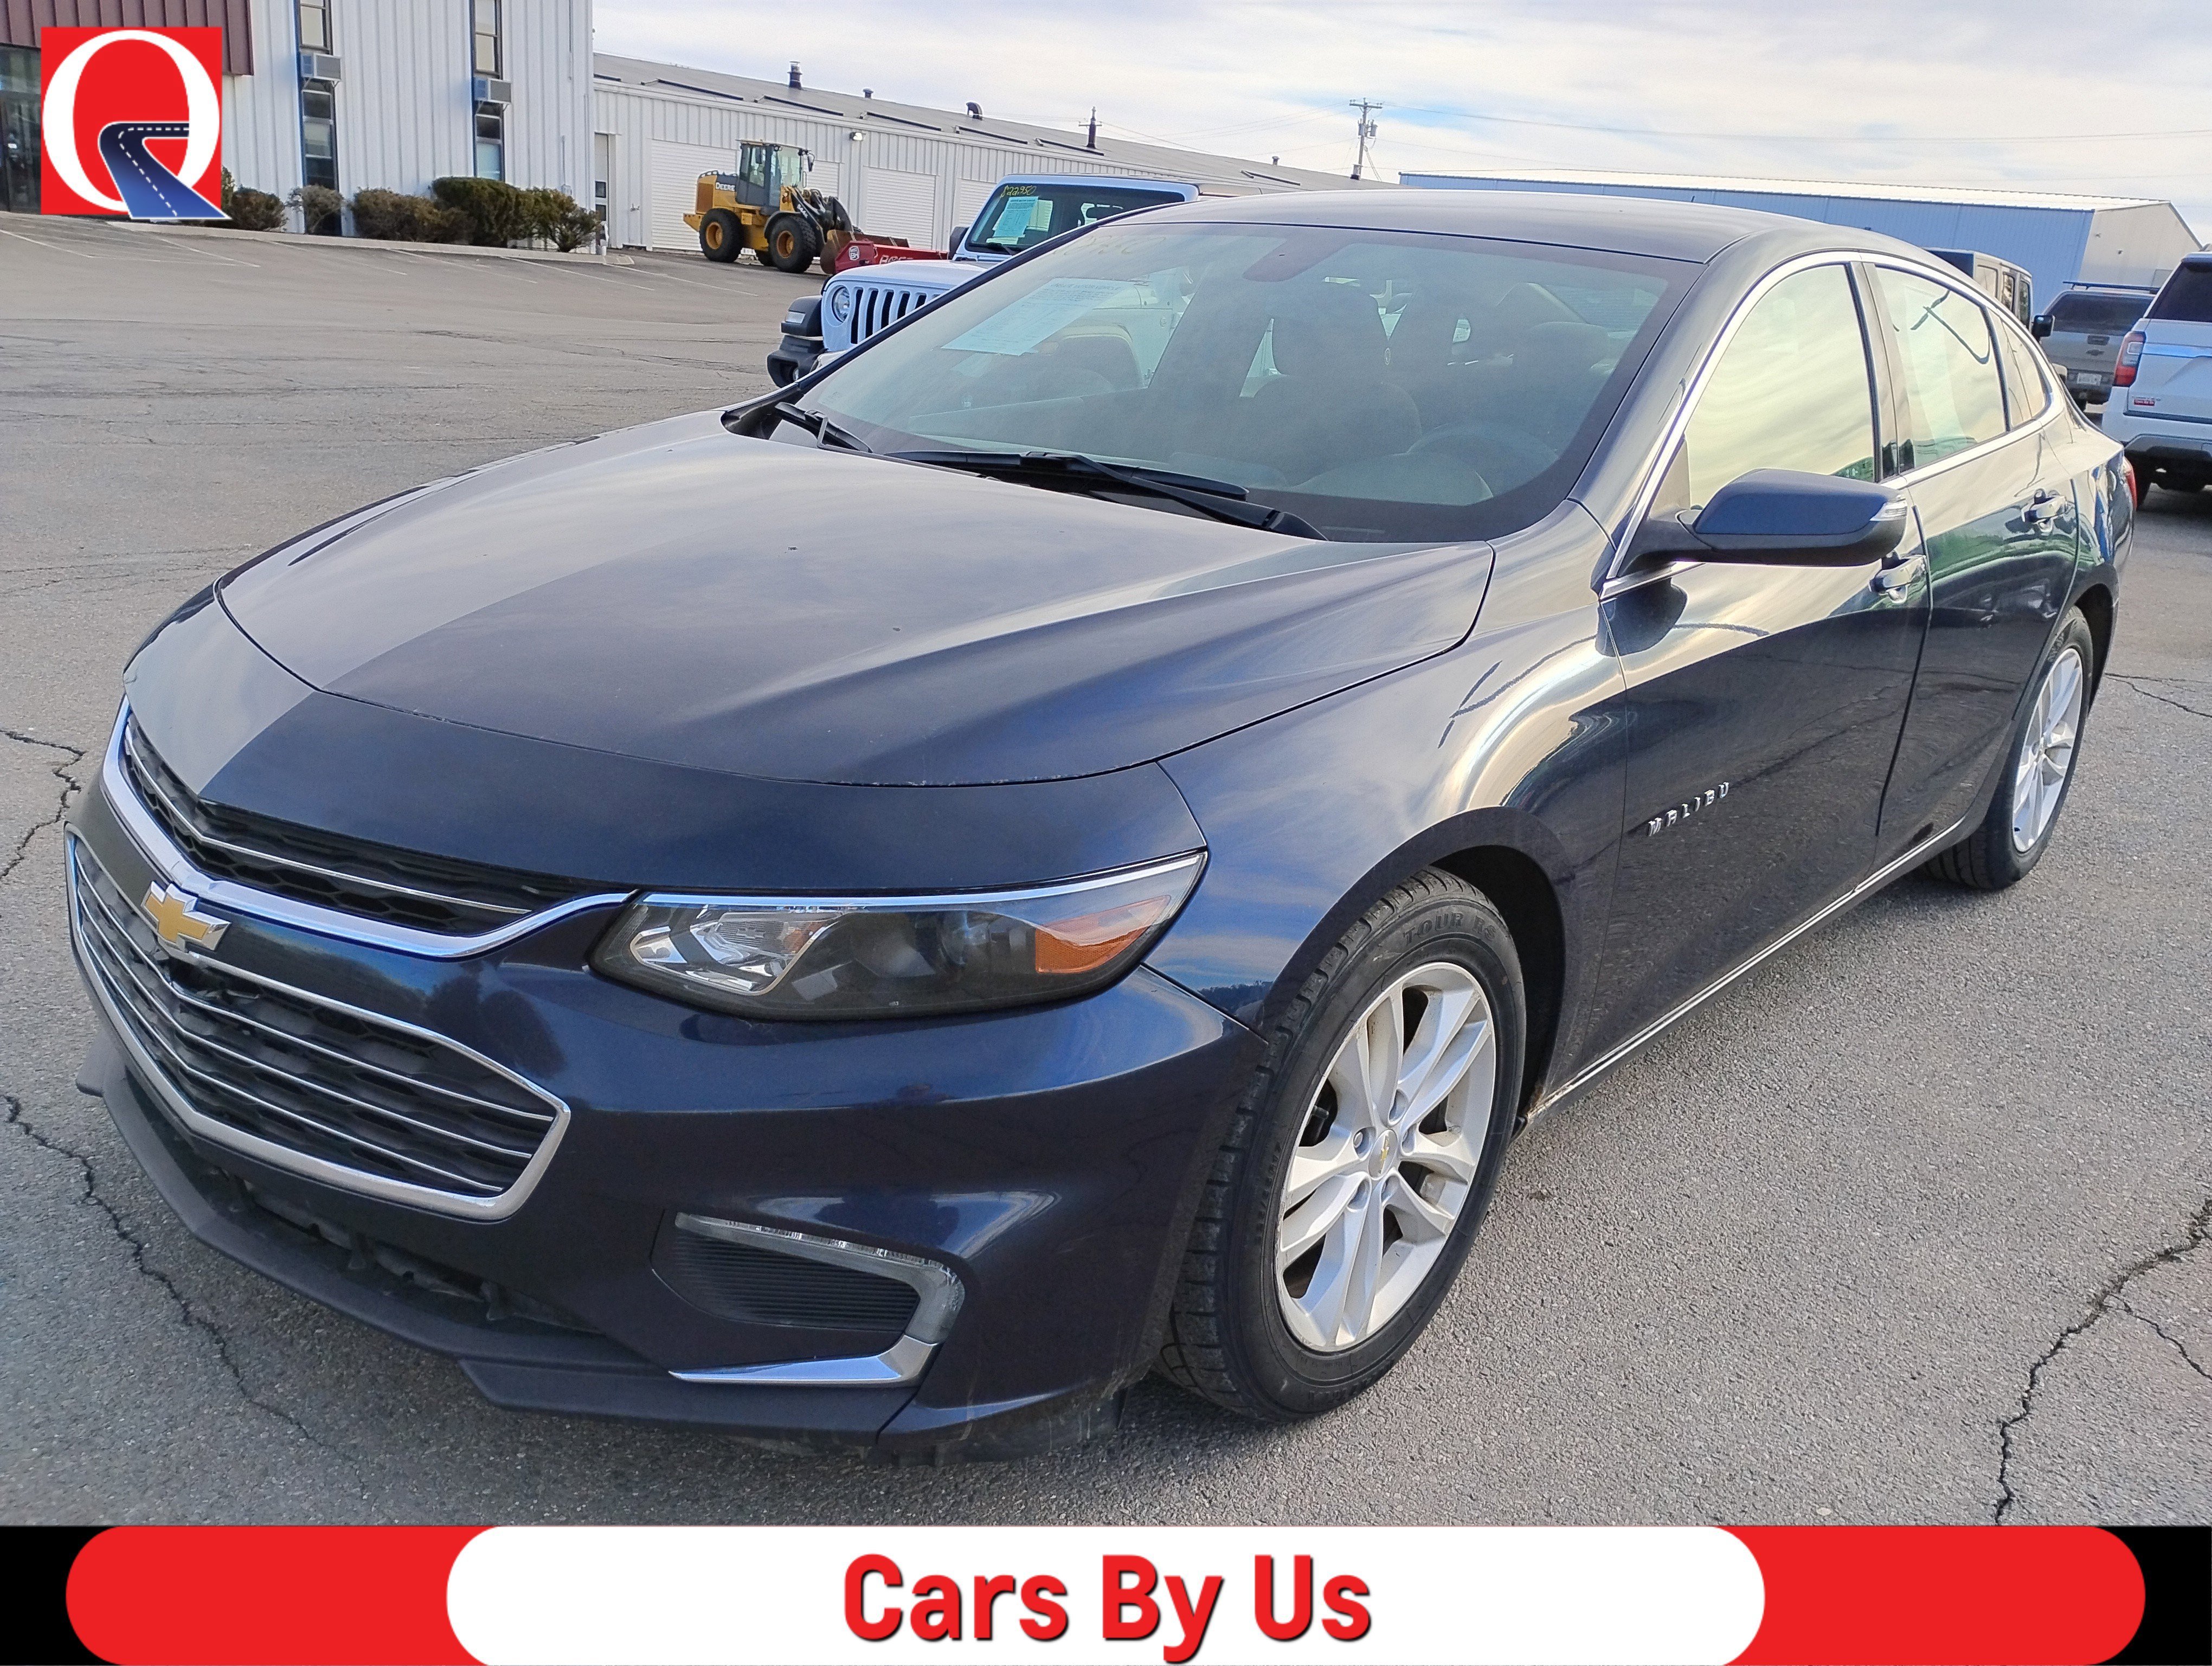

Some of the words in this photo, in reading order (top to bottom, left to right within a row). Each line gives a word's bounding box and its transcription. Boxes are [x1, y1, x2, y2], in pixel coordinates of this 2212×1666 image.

[716, 182, 735, 191] DEERE
[1648, 781, 1729, 837] MALIBU
[1403, 912, 1464, 946] TOUR
[1472, 915, 1497, 941] RS
